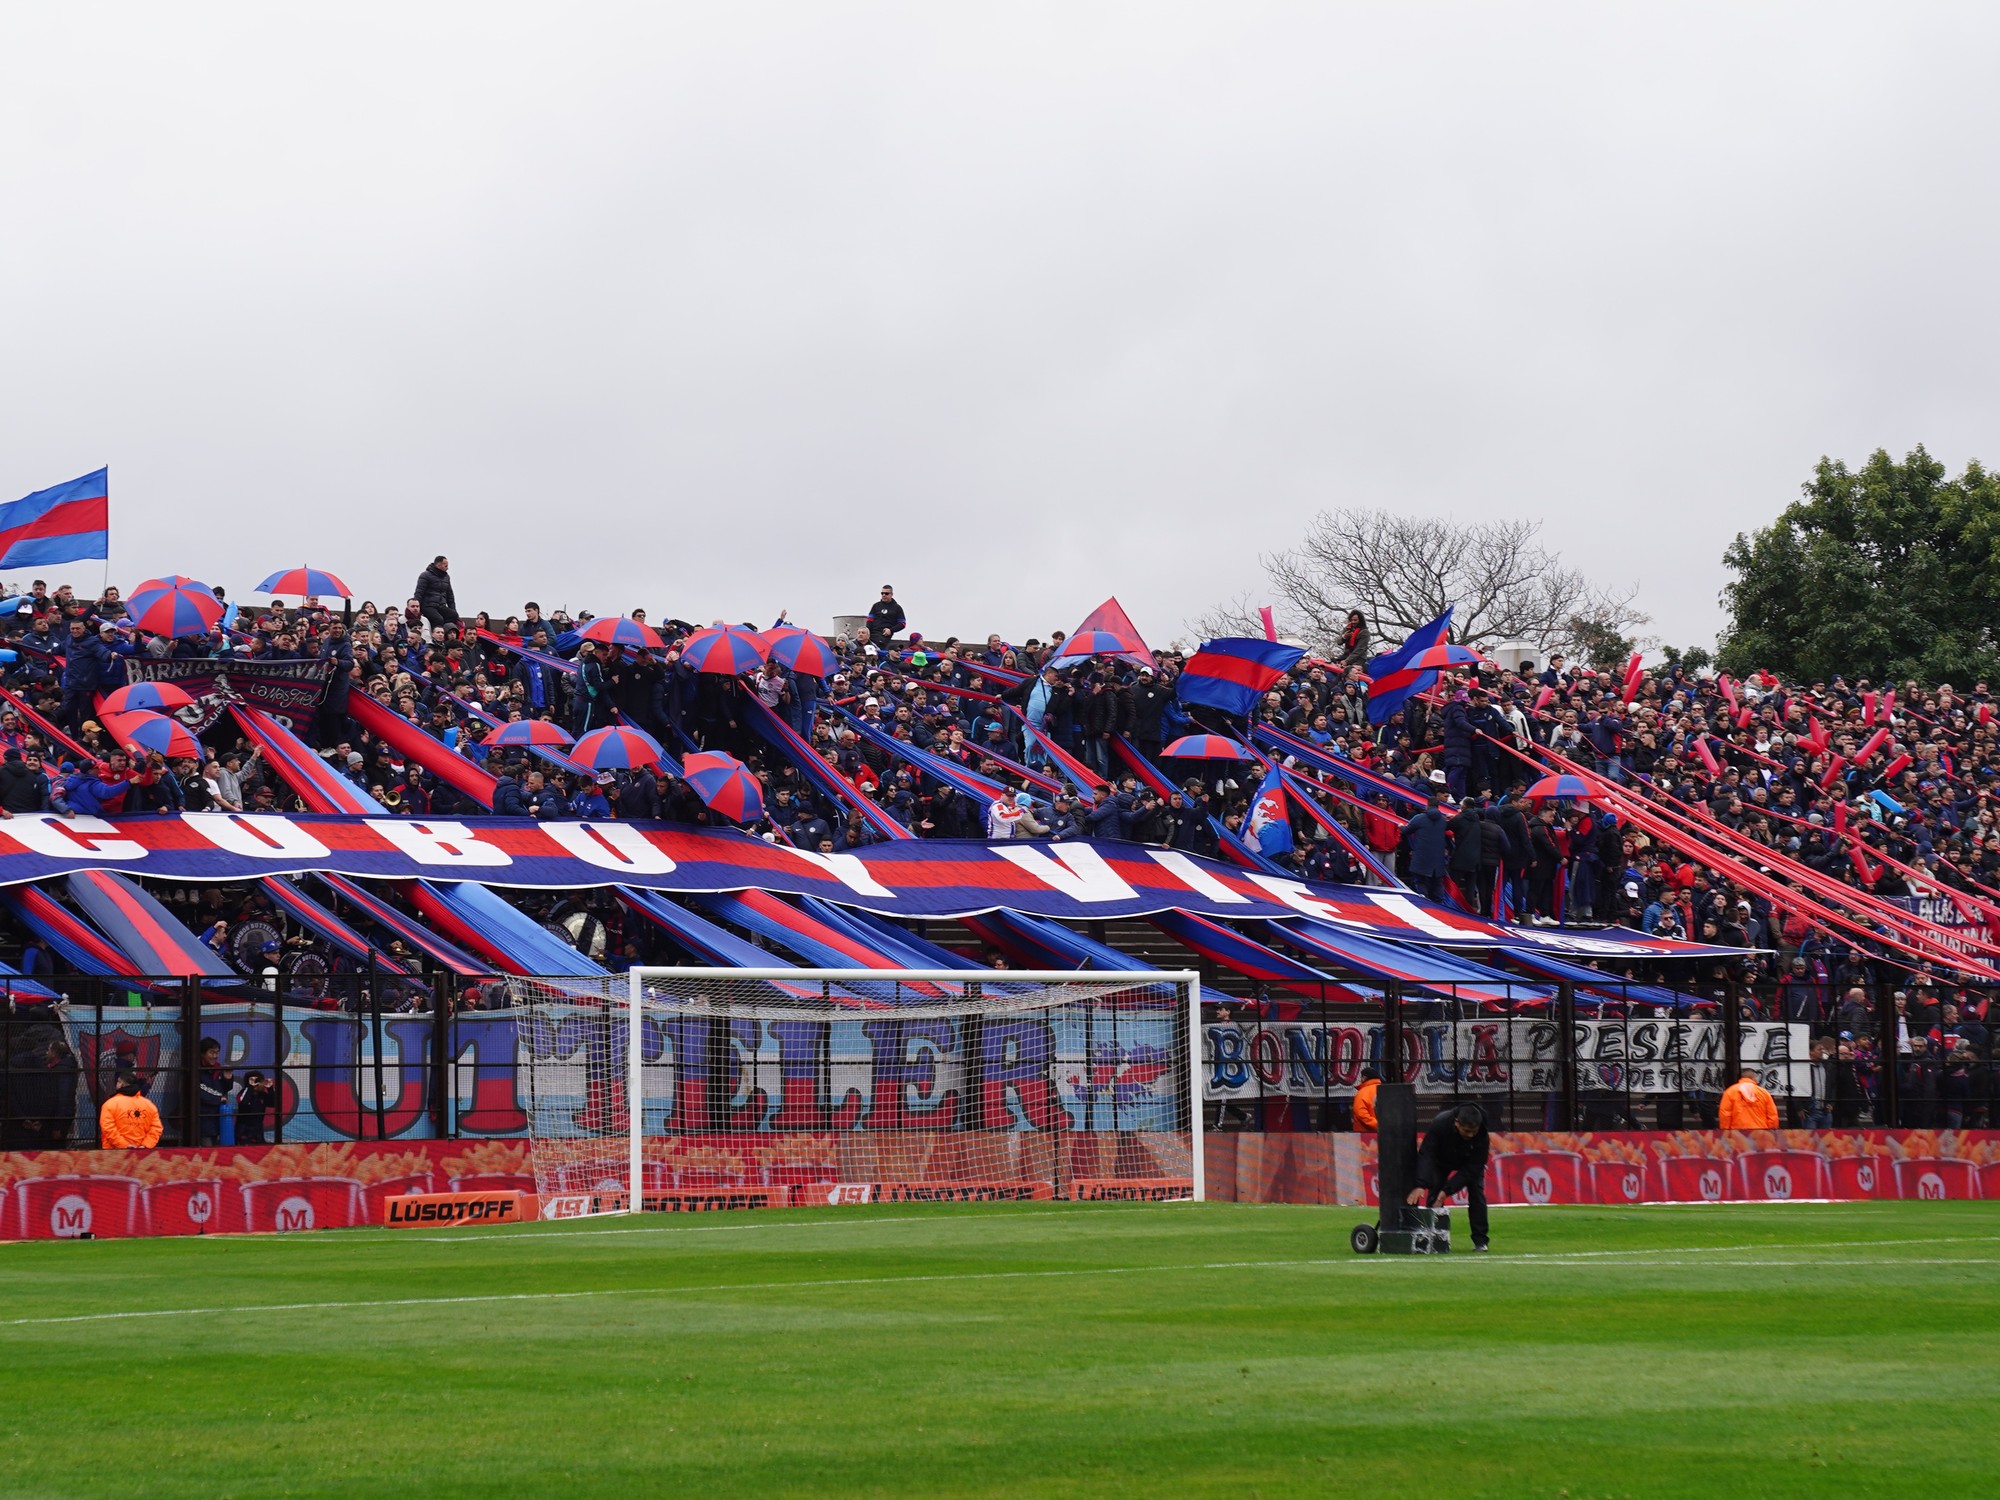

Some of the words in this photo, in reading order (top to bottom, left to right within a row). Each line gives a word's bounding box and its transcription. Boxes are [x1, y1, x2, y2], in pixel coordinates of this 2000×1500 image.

[124, 658, 210, 686] BARRIO
[777, 843, 898, 899] Y
[986, 842, 1499, 941] VIEL
[1528, 1022, 1792, 1065] PRESENTE
[175, 1011, 1075, 1140] BUTTELER
[1526, 1176, 1547, 1196] M
[1703, 1177, 1720, 1195] M
[1768, 1175, 1788, 1193] M
[1921, 1181, 1941, 1200] M
[57, 1206, 84, 1229] M
[191, 1200, 208, 1215] M
[389, 1200, 515, 1222] LÜSQTOFF
[281, 1208, 307, 1230] M
